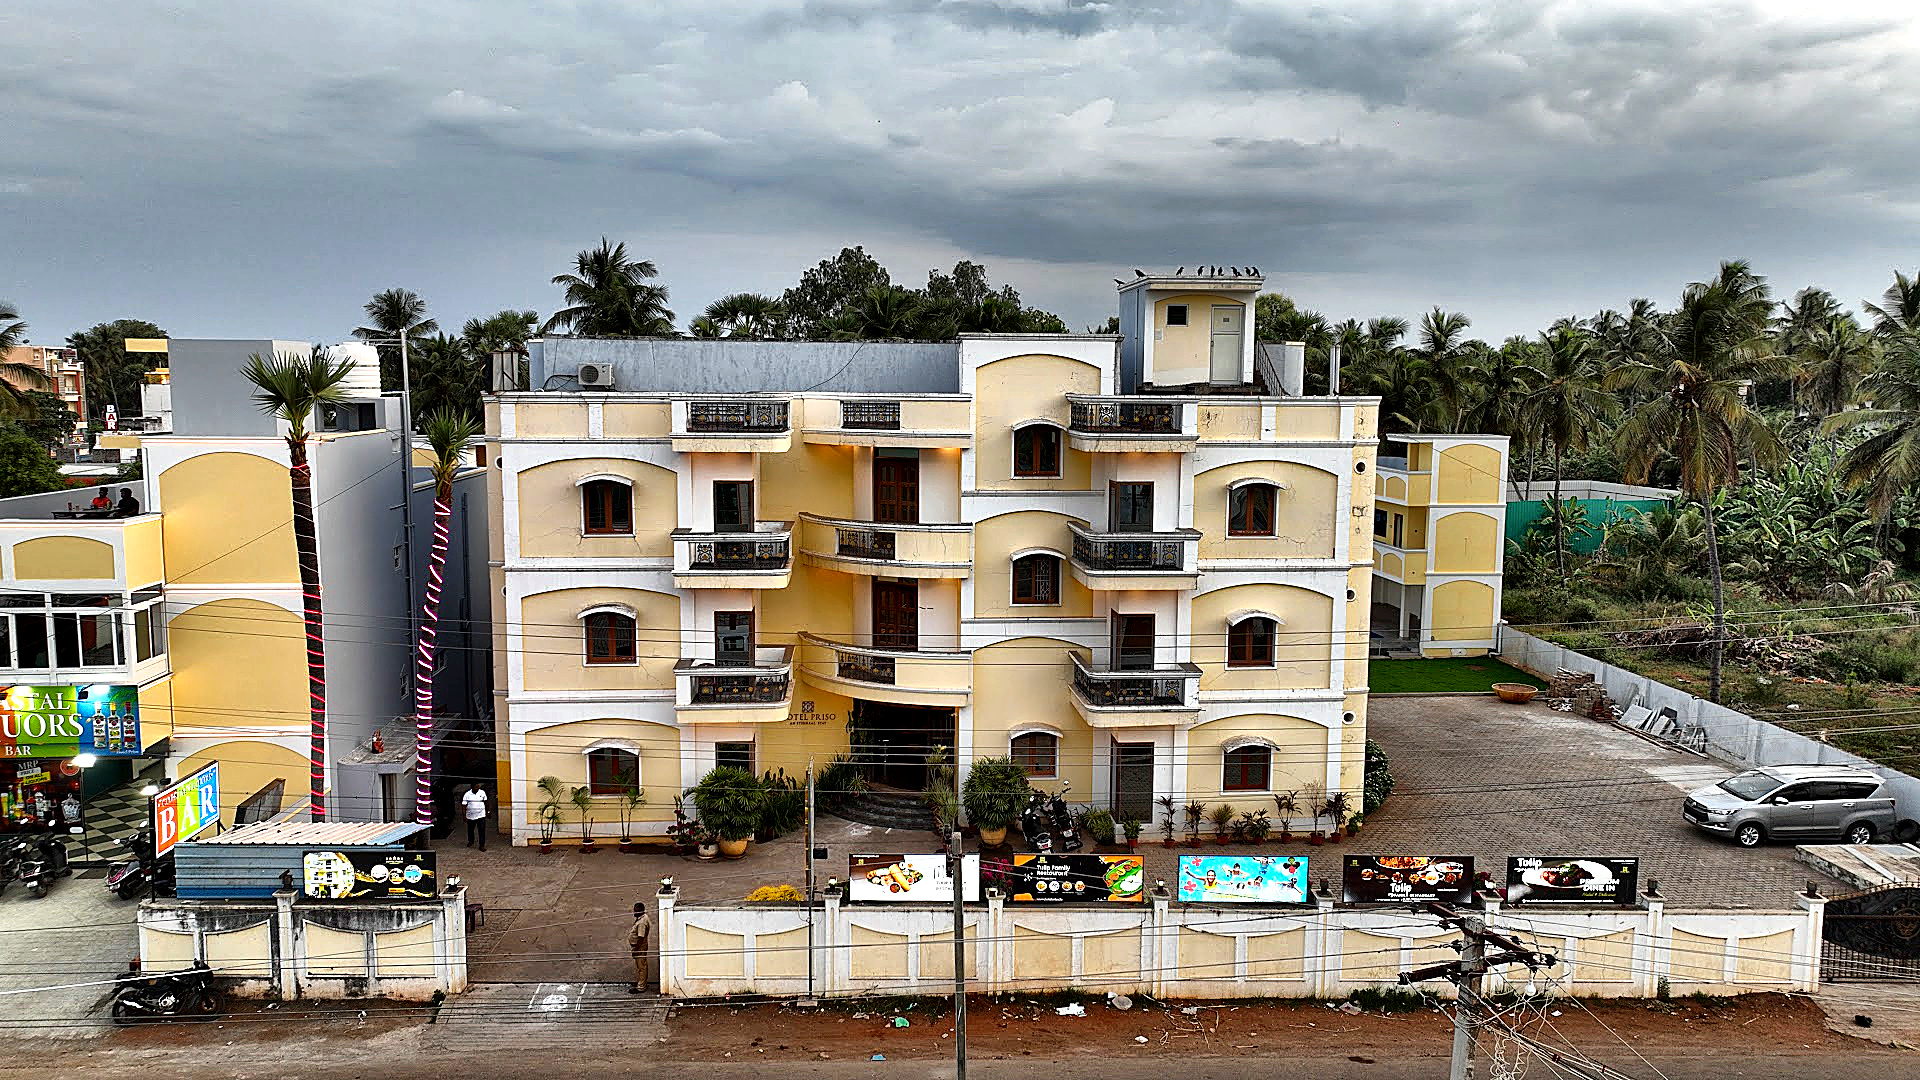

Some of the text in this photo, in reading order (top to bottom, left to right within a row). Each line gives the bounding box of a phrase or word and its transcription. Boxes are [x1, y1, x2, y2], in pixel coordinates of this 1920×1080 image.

[106, 404, 117, 430] BAR
[5, 745, 32, 756] BAR
[18, 760, 39, 770] MRP
[159, 784, 217, 845] BAR
[1390, 882, 1413, 898] Tulip
